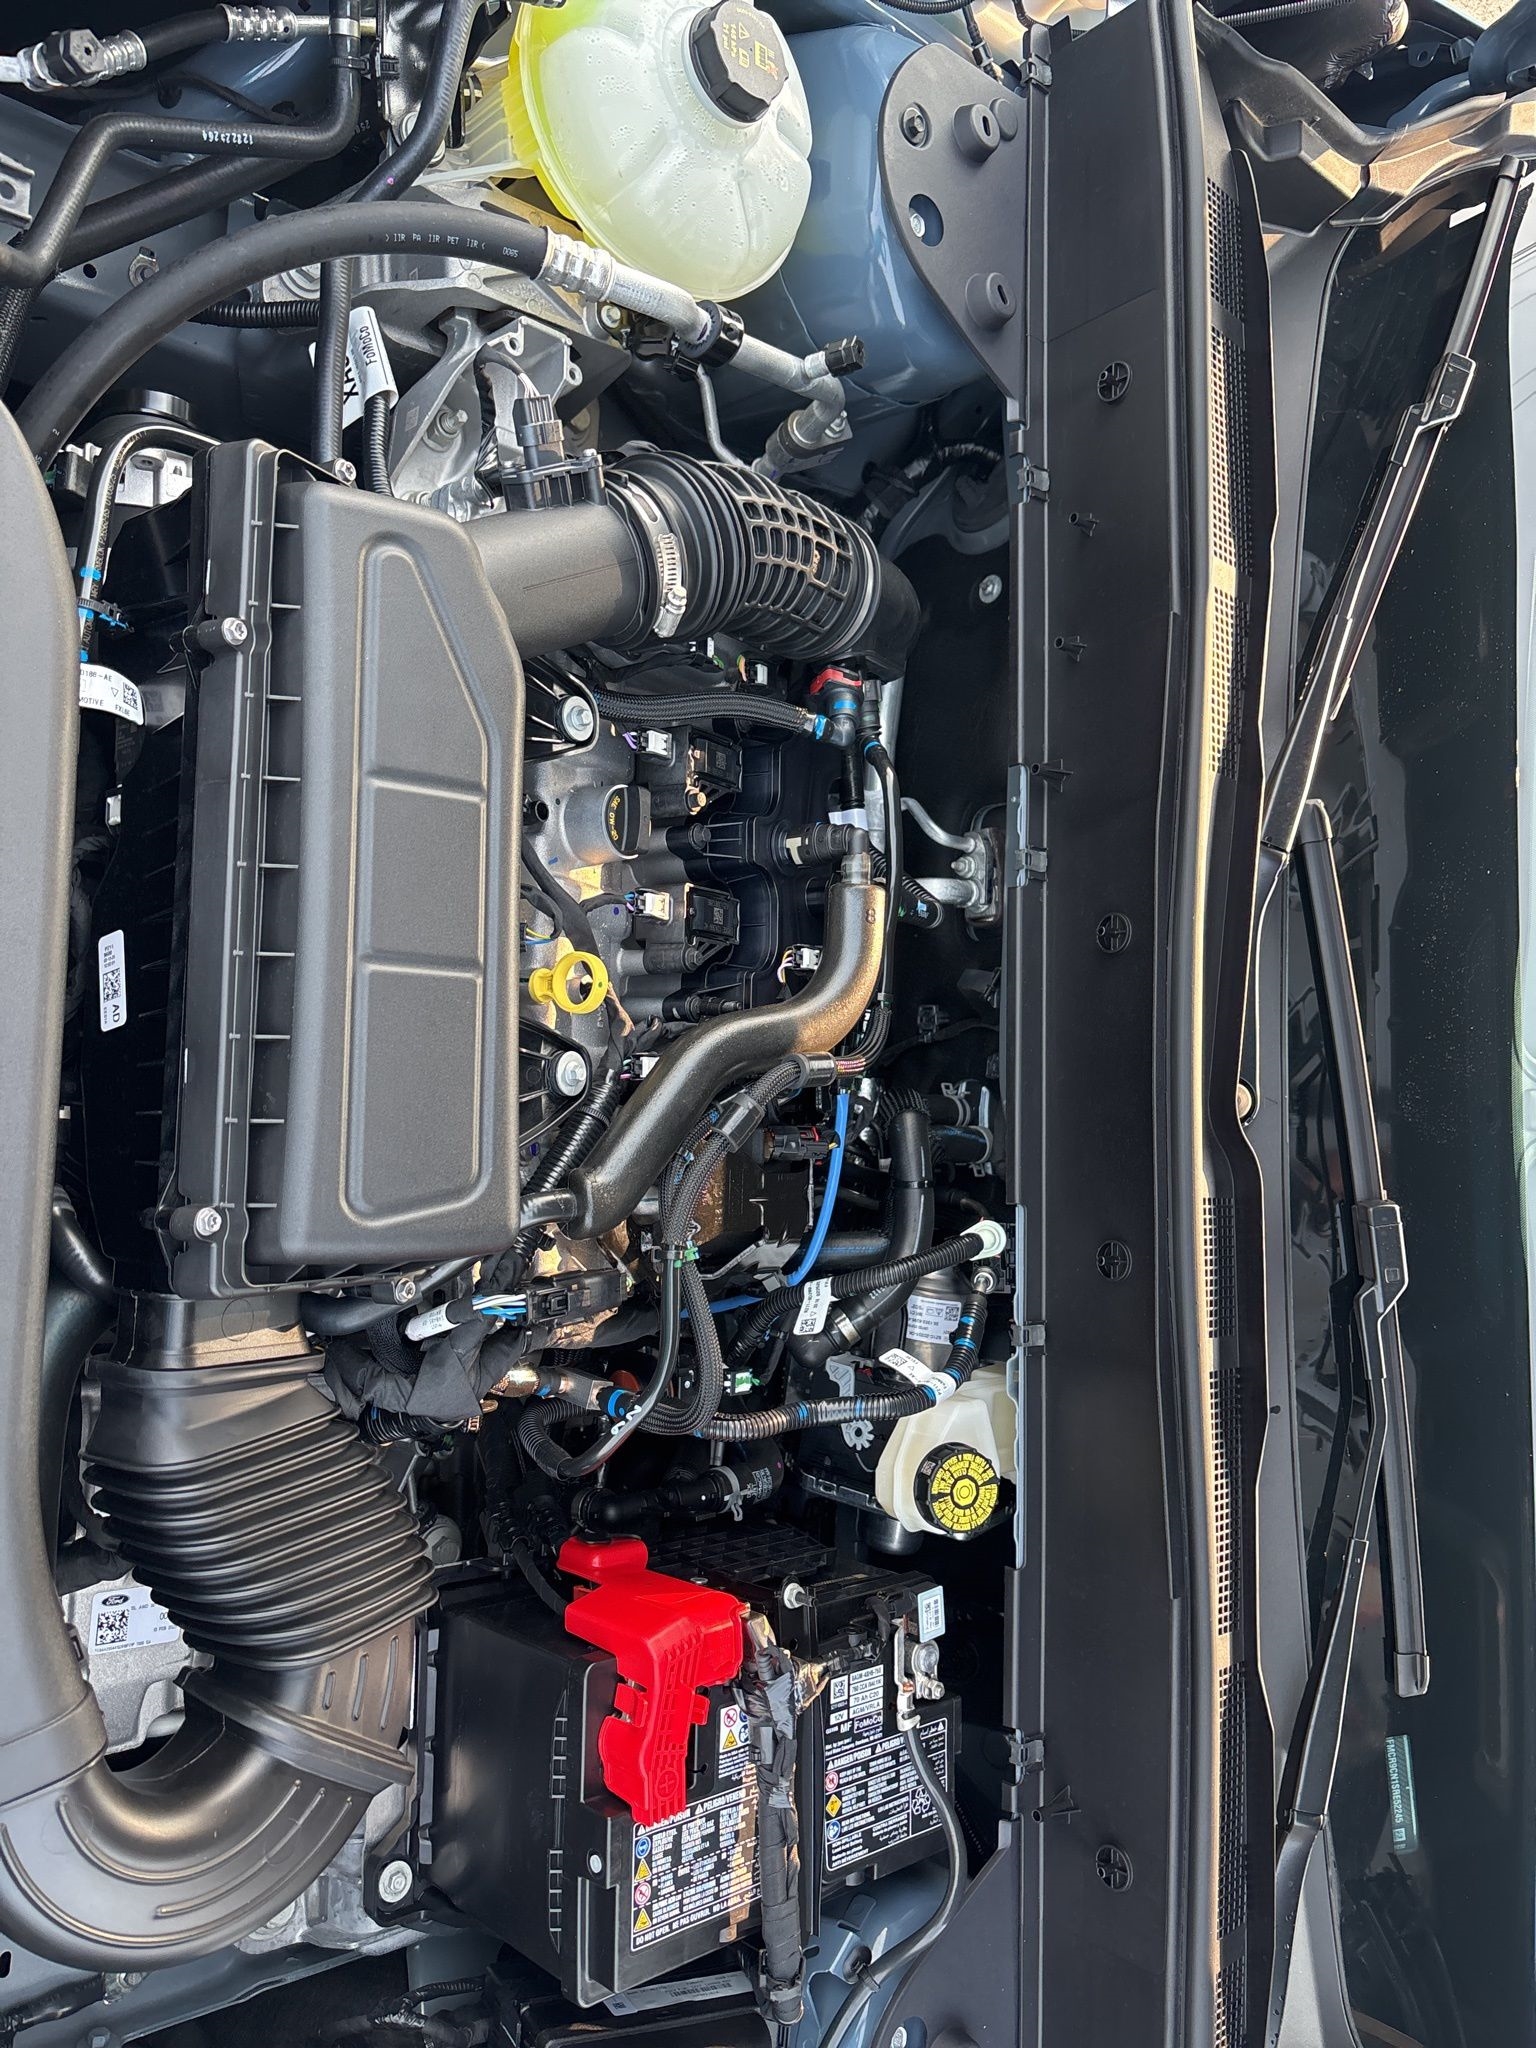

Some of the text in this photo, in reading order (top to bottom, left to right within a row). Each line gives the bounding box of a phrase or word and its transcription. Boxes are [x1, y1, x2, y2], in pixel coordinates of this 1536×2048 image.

[412, 233, 421, 242] PA
[447, 235, 460, 244] PET
[112, 1004, 120, 1022] AD
[869, 1690, 880, 1699] C20
[840, 1722, 852, 1734] MF
[855, 1715, 882, 1730] FoMoCo
[636, 1936, 644, 1945] DO
[644, 1931, 655, 1942] NOT
[656, 1926, 670, 1938] OPEN.
[680, 1918, 690, 1930] PAS
[690, 1910, 711, 1928] OUVRIR.
[713, 1902, 720, 1914] NO
[720, 1900, 728, 1912] LA
